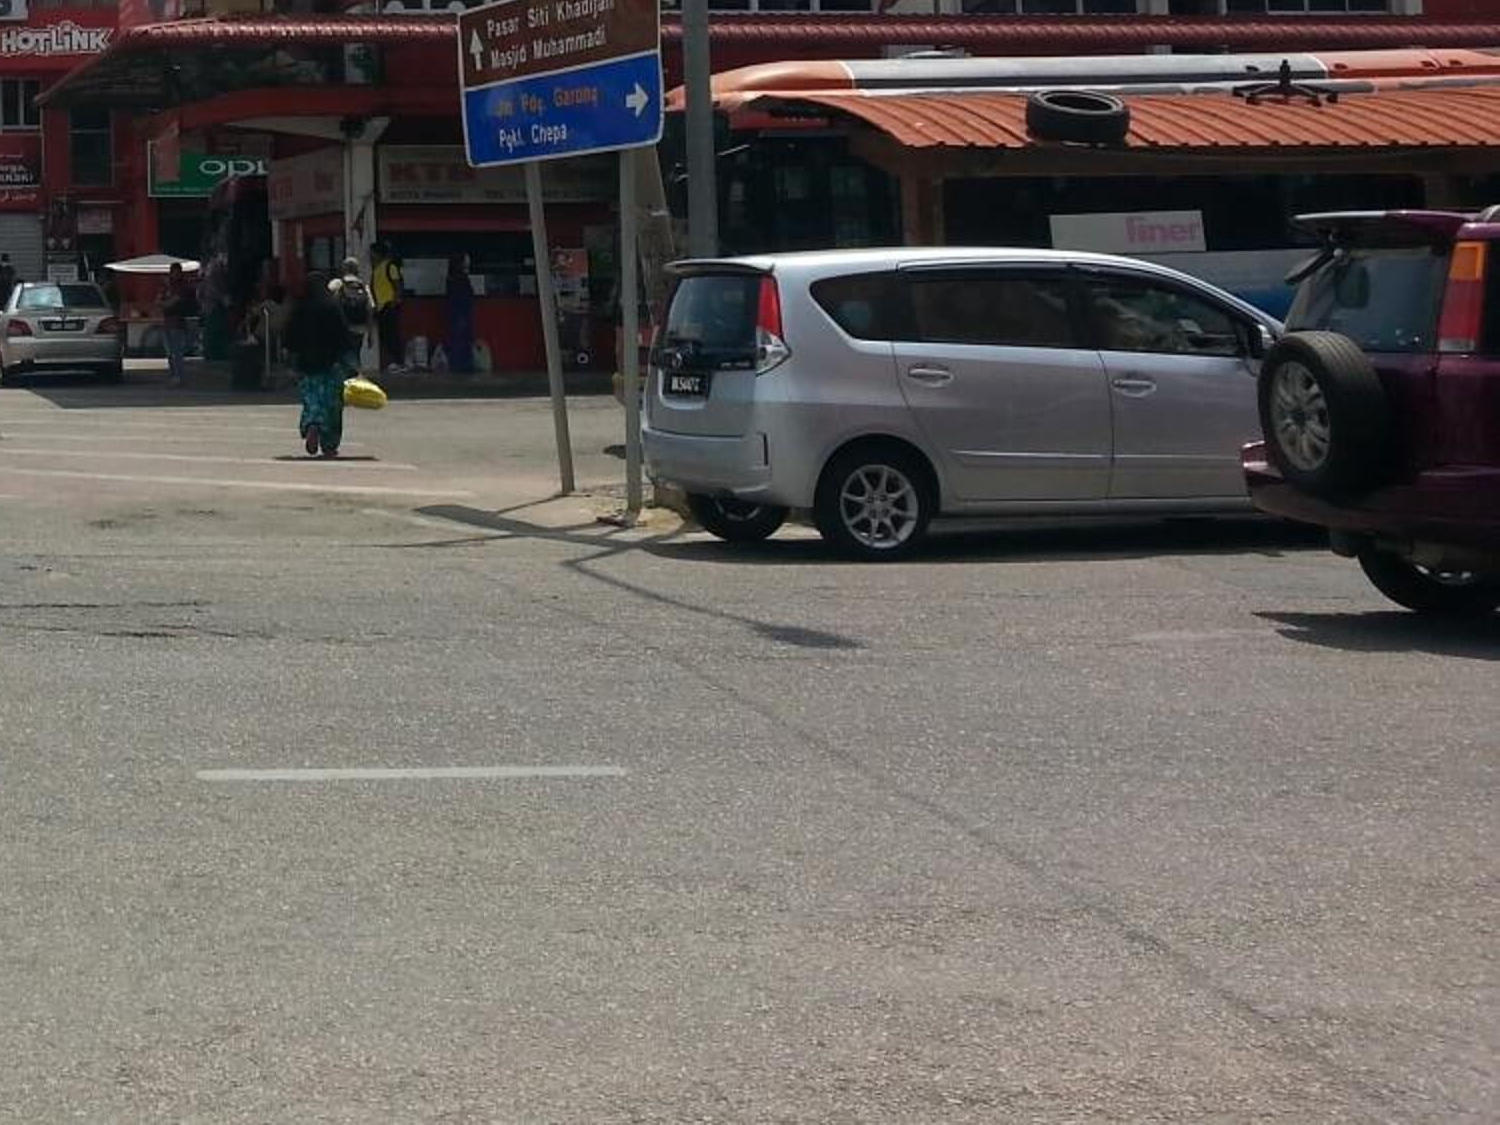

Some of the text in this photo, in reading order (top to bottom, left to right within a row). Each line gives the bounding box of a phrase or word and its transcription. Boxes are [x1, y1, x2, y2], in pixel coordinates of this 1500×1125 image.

[487, 16, 520, 39] Pasar
[527, 2, 549, 28] Siti
[491, 25, 607, 69] Masjid Muhammadi
[532, 123, 568, 146] Chepa
[1125, 215, 1200, 243] liner
